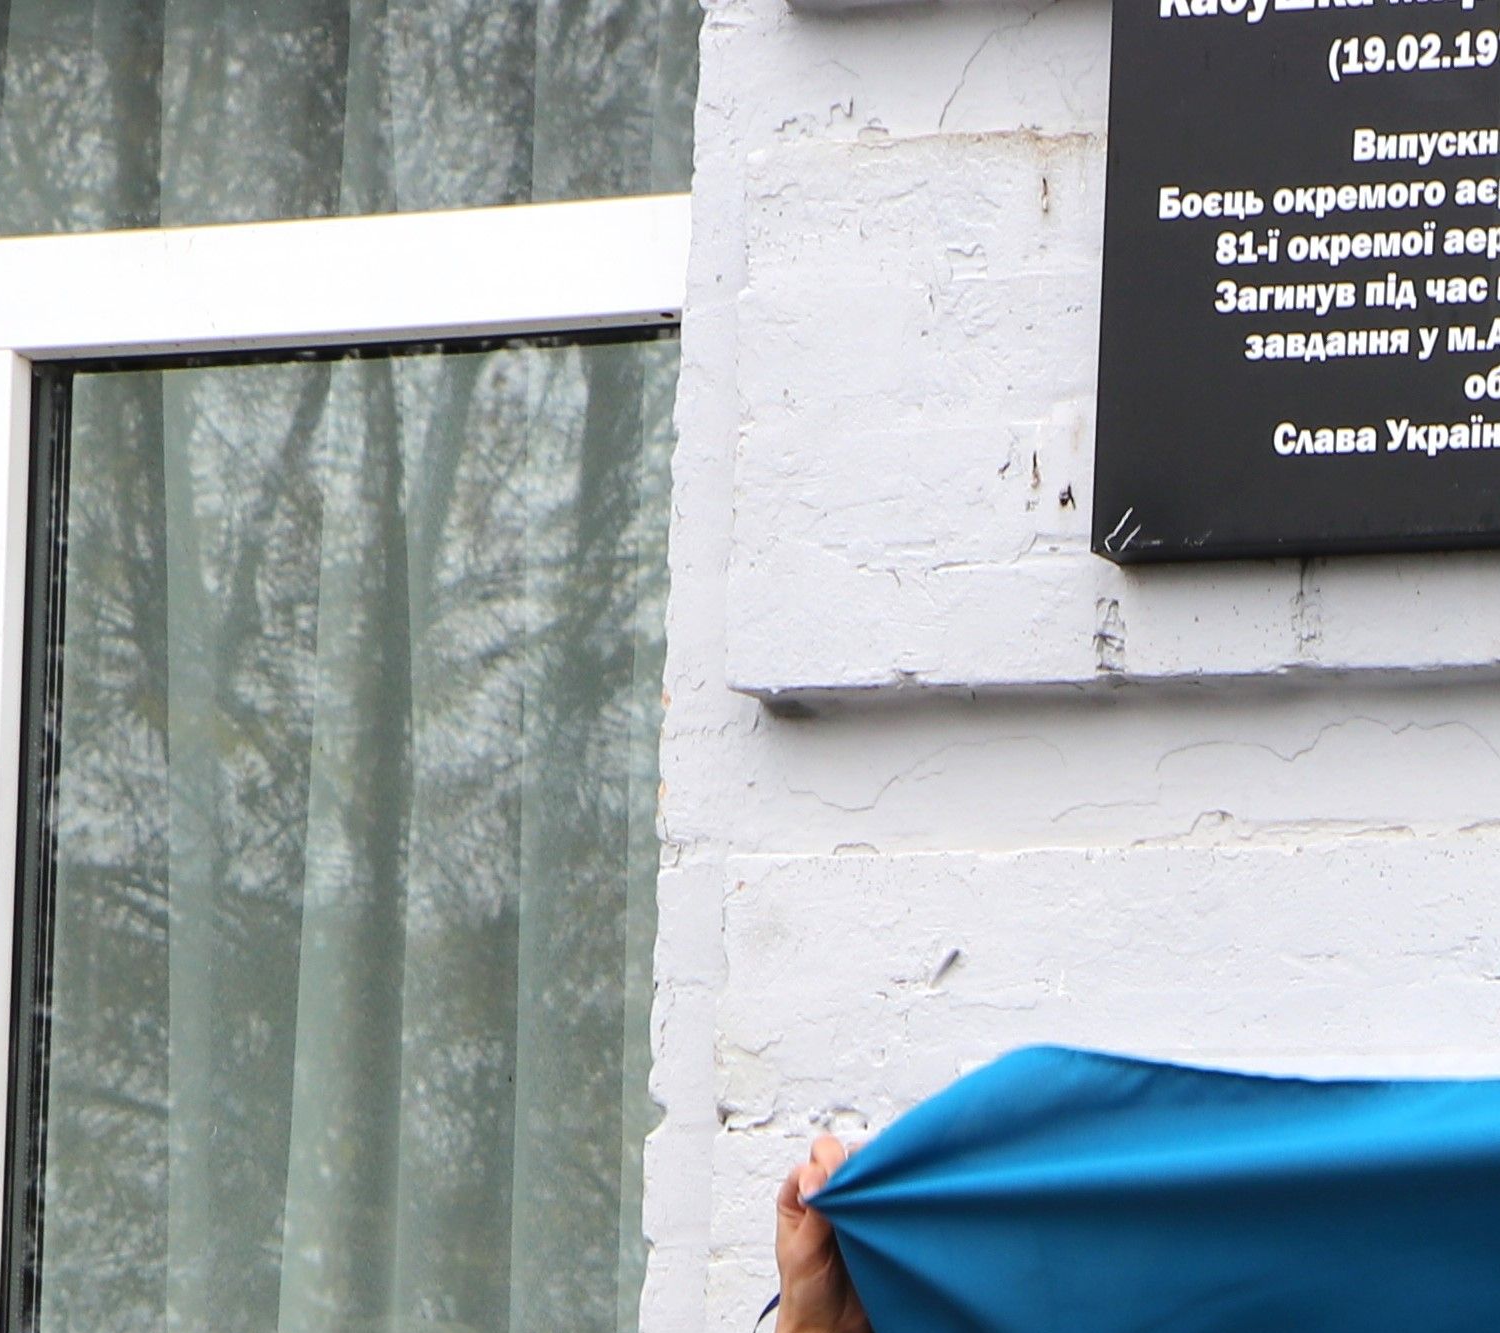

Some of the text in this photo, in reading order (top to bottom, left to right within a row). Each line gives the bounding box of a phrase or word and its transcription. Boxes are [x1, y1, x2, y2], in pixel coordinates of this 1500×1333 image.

[1158, 186, 1264, 220] Боєць
[1272, 180, 1446, 219] окремого
[1215, 228, 1281, 265] 81-ї
[1287, 221, 1436, 266] окремої
[1214, 280, 1356, 316] Загинув
[1365, 272, 1417, 310] під
[1425, 276, 1488, 304] час
[1244, 328, 1410, 362] завдання
[1418, 327, 1439, 360] у
[1273, 422, 1377, 455] Слава
